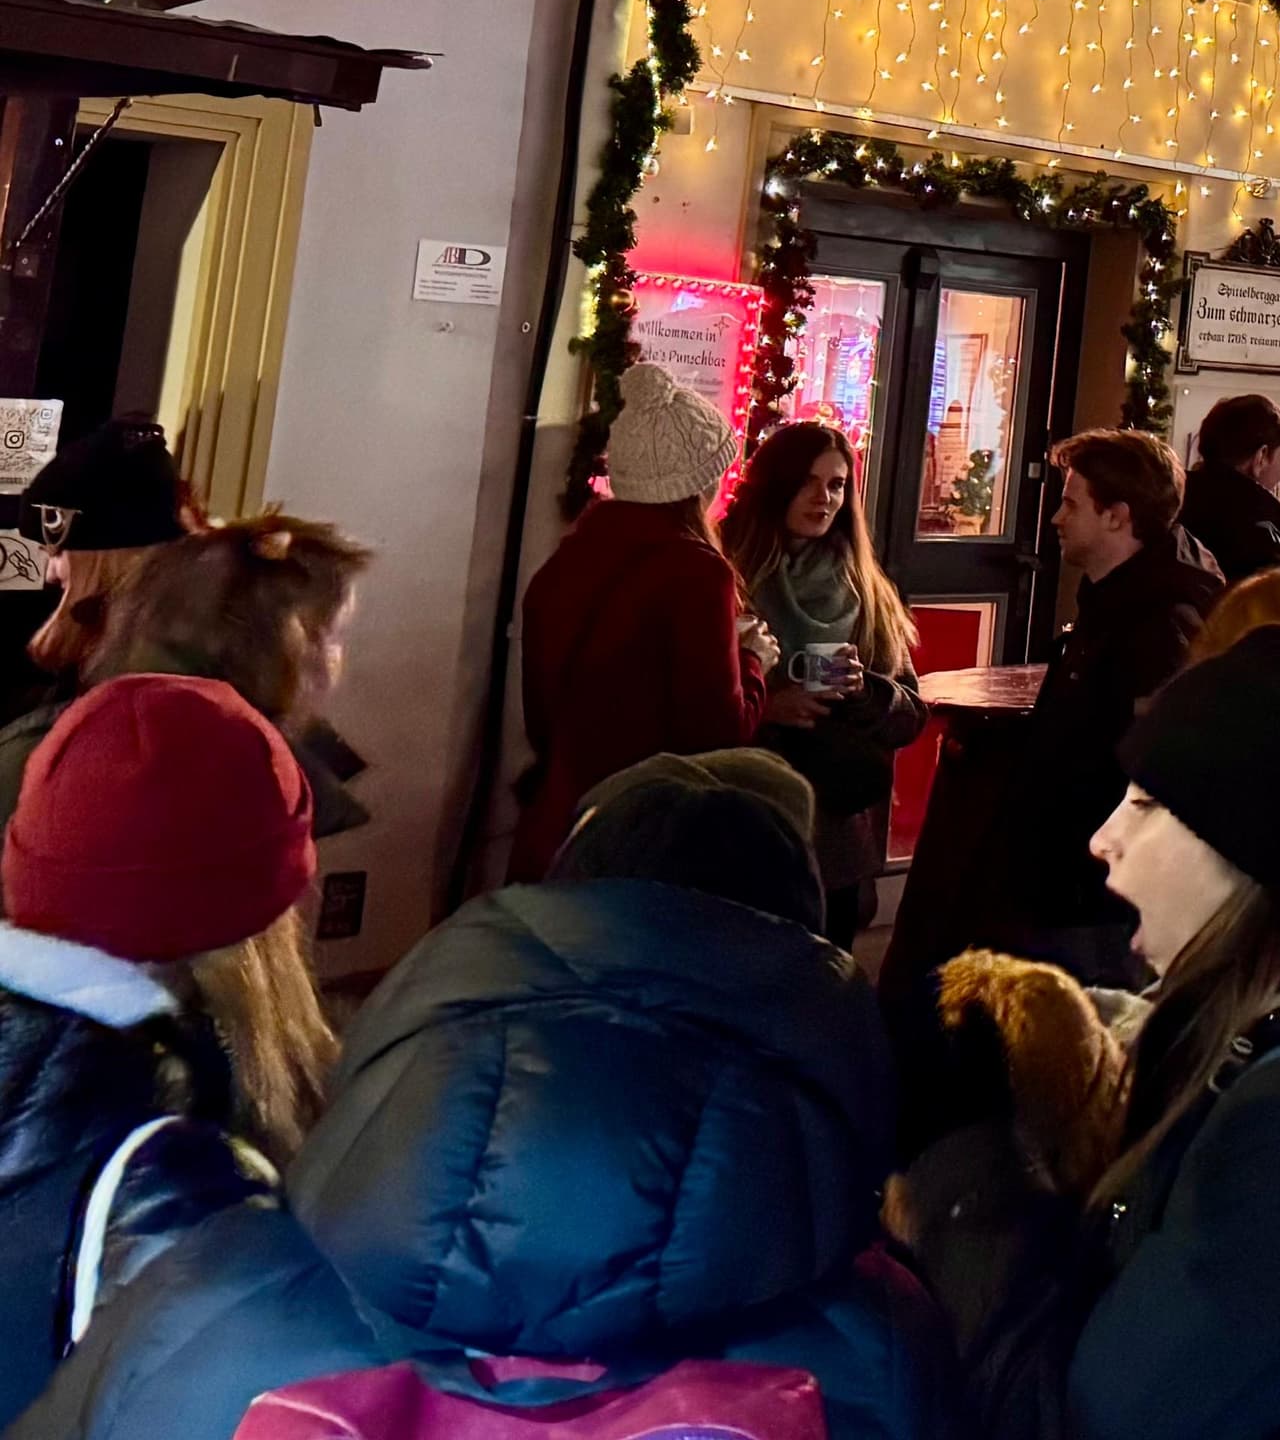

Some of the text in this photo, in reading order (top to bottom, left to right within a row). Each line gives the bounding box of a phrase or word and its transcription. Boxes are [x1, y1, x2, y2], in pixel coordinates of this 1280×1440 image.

[1196, 297, 1225, 321] Zum
[637, 319, 717, 343] Willkommen in
[668, 349, 726, 368] Punschbar
